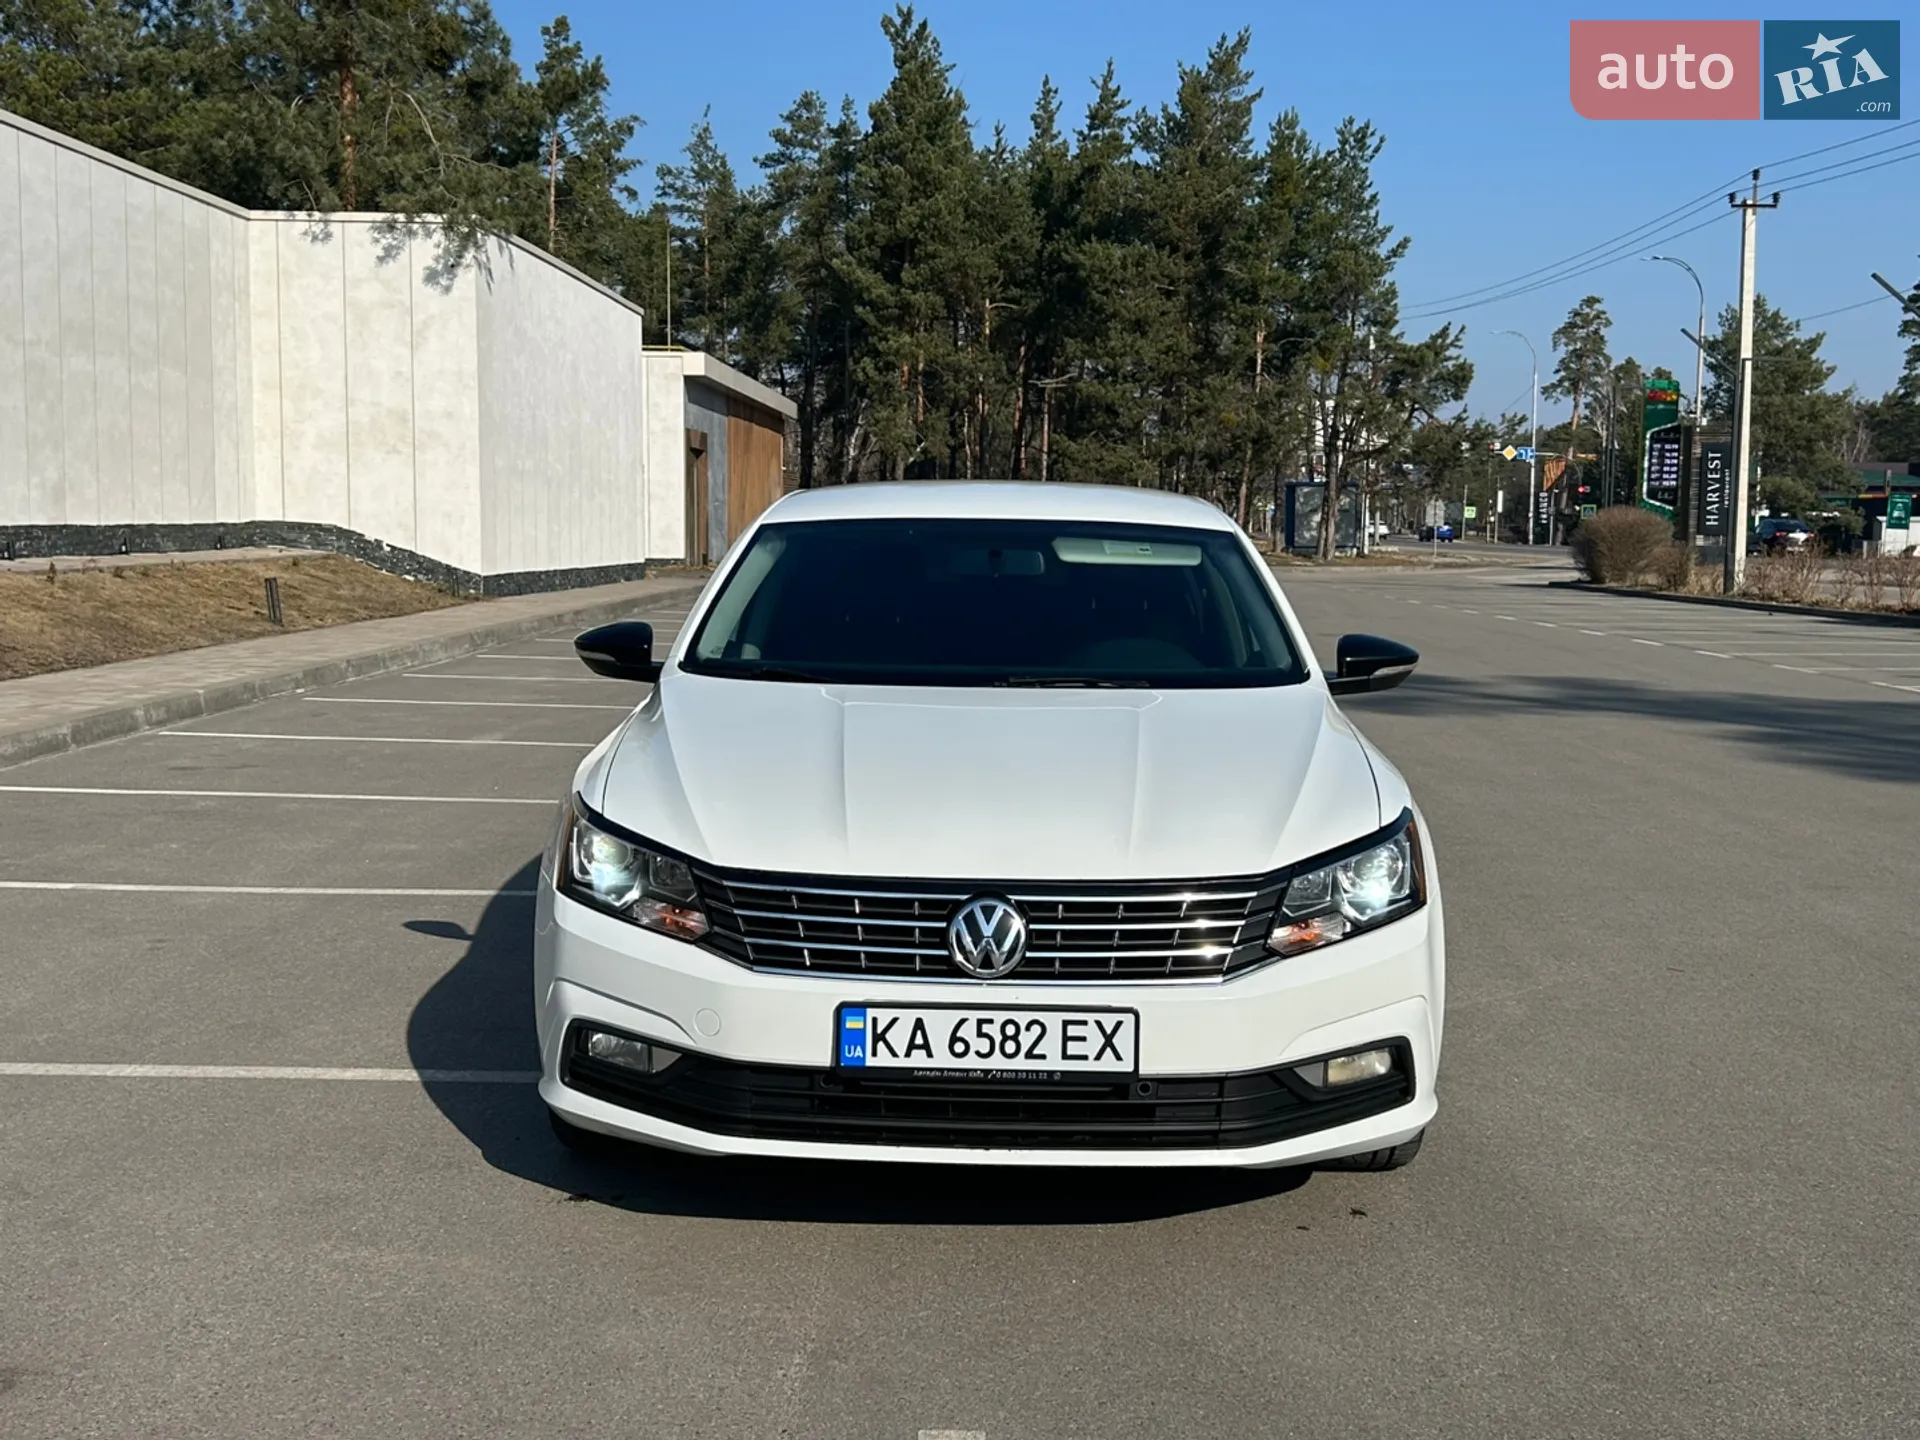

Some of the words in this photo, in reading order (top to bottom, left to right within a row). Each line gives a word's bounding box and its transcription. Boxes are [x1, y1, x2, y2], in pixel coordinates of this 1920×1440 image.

[1705, 451, 1722, 526] HARVEST
[845, 1045, 863, 1059] UA
[870, 1016, 934, 1059] KA
[947, 1017, 1047, 1061] 6582
[1060, 1019, 1124, 1062] EX
